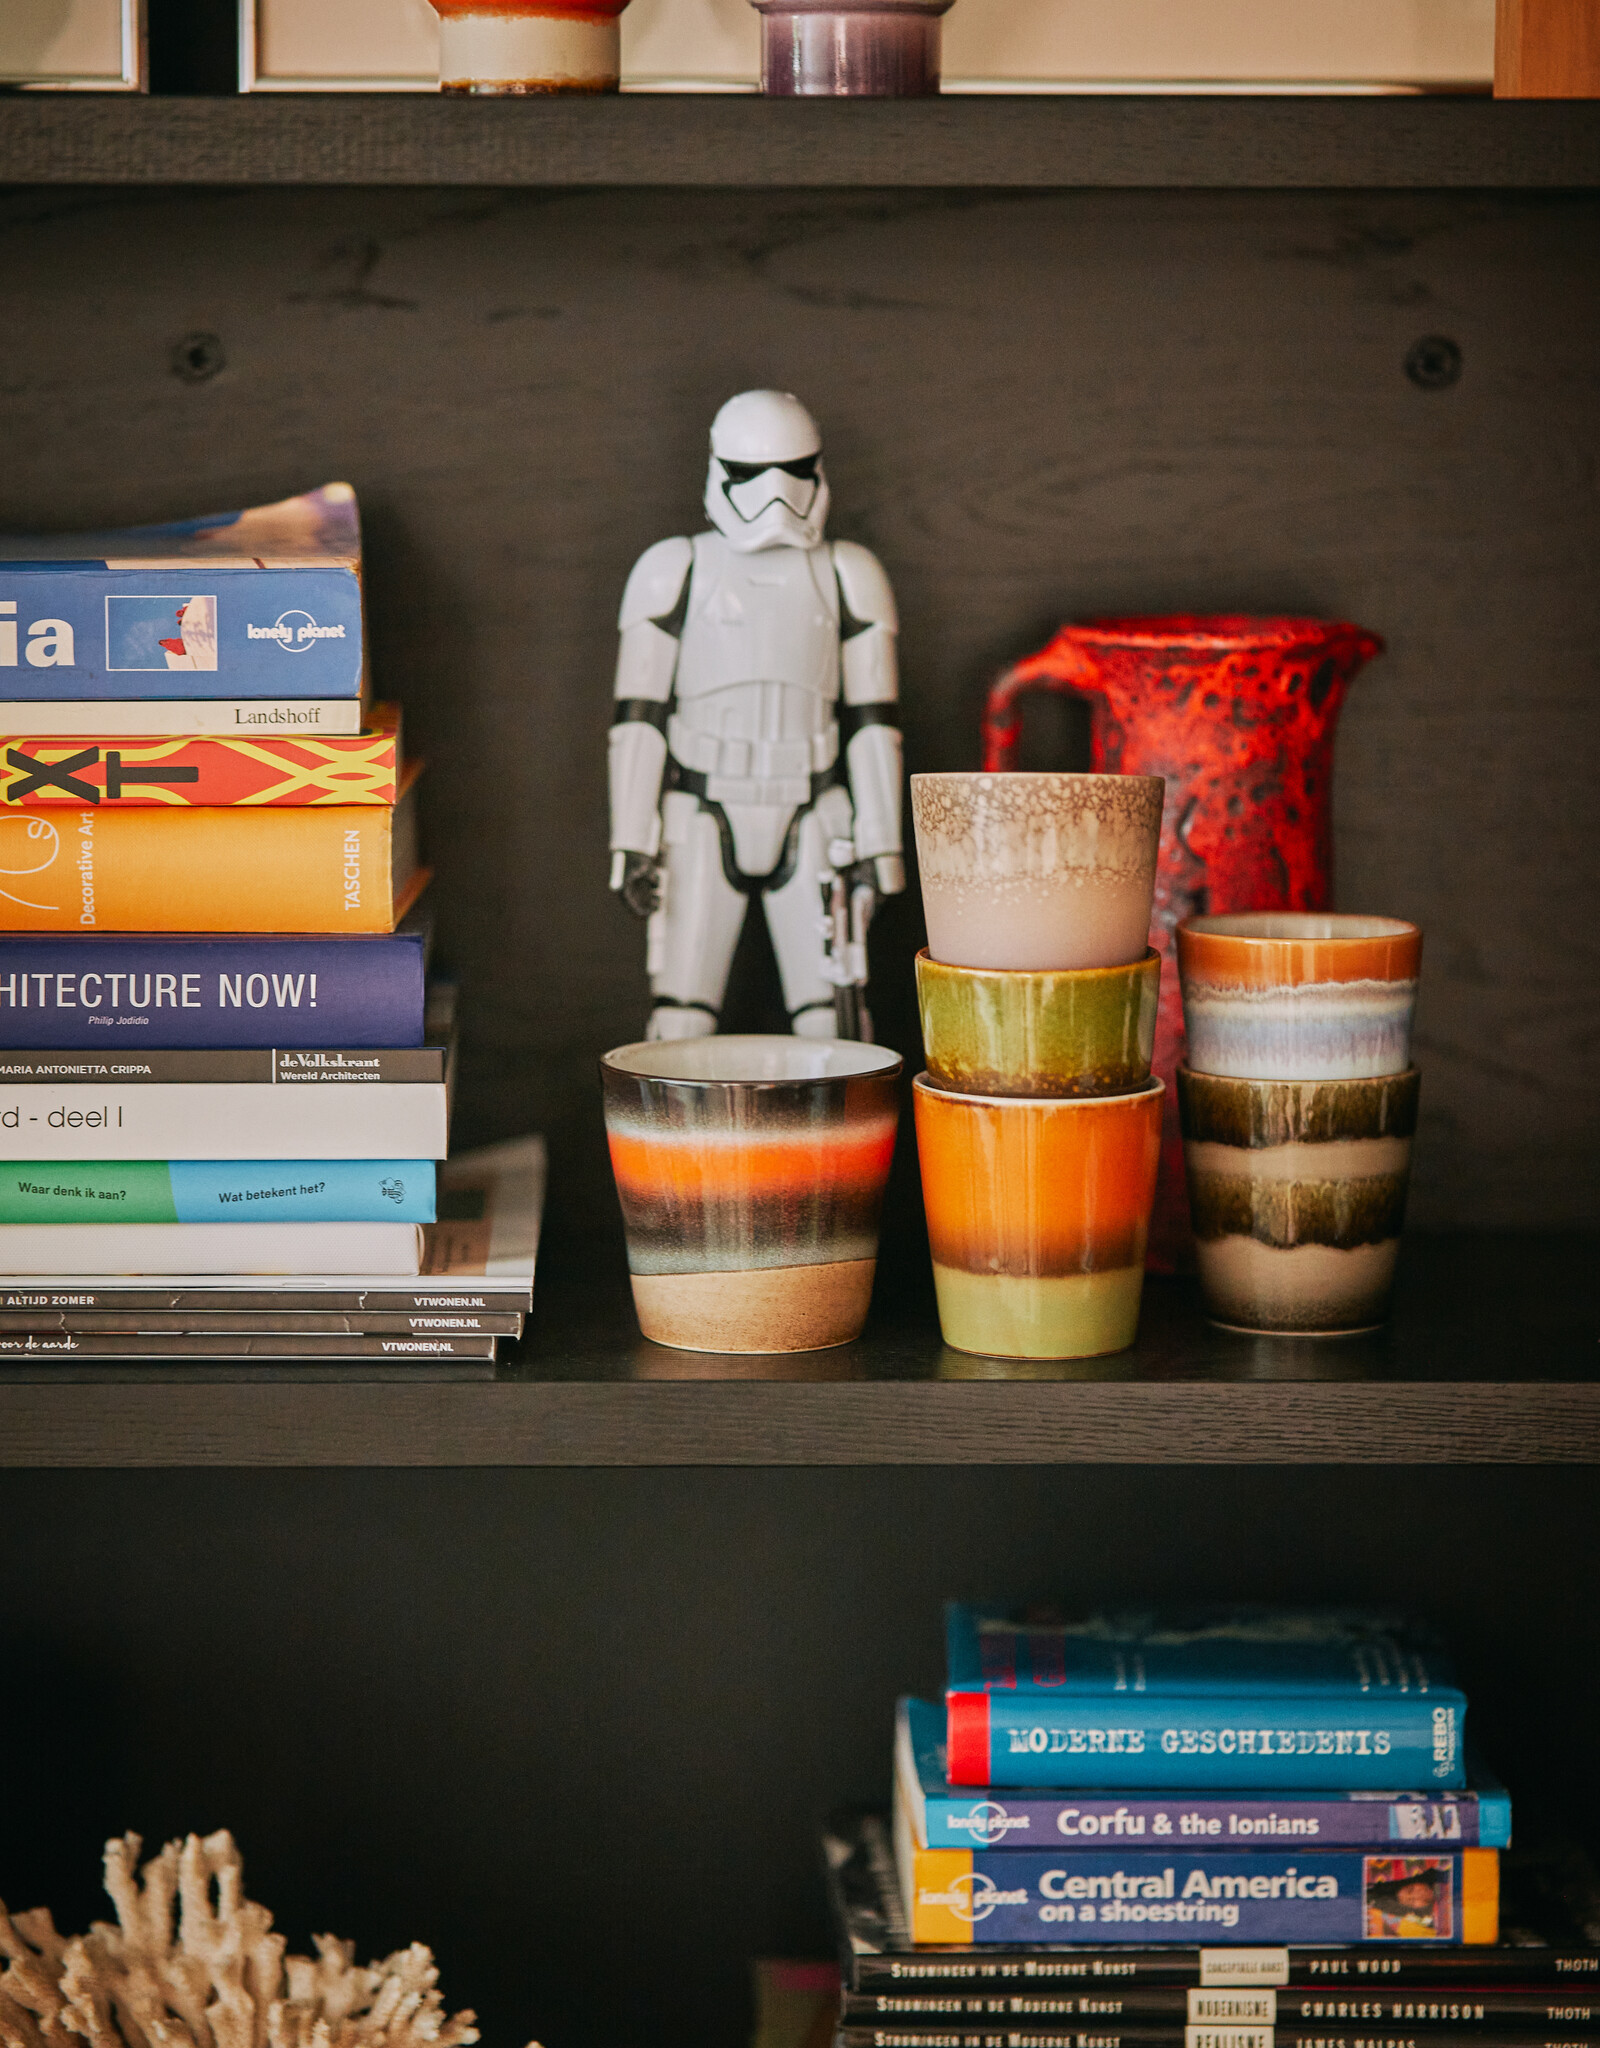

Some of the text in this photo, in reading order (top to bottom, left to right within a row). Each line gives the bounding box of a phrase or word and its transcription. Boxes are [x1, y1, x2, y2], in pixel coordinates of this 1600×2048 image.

[247, 623, 346, 643] lonely planet
[234, 708, 321, 724] Landshoff
[77, 811, 96, 925] Decorative Art
[343, 830, 361, 911] TASCHEN
[218, 973, 317, 1008] NOW!
[88, 1015, 149, 1026] Philip Jodidio
[35, 1065, 108, 1075] ANTONIETTA
[110, 1065, 152, 1075] CRIPPA
[280, 1071, 381, 1080] Wereld Architecten
[47, 1106, 107, 1128] deel
[18, 1181, 126, 1201] Waar denk ik aan?
[218, 1181, 325, 1203] Wat betekent het?
[6, 1296, 48, 1305] ALTIJD
[51, 1296, 95, 1305] ZOMER
[413, 1297, 486, 1307] VTWONEN.NL
[409, 1318, 481, 1328] VTWONEN.NL
[24, 1335, 40, 1350] de
[41, 1335, 80, 1350] aarde
[382, 1342, 454, 1352] VTWONEN.NL
[1008, 1728, 1392, 1755] MODERNE GESCHIEDENIS
[1432, 1706, 1447, 1761] REBO
[1056, 1807, 1320, 1836] Corfu & the Ionians
[1038, 1867, 1339, 1900] Central America
[1038, 1899, 1240, 1928] on a shoestring
[1309, 1959, 1349, 1975] PAUL
[1555, 1958, 1599, 1972] THOTH
[1300, 2002, 1485, 2019] CHARLES HARRISON
[1546, 2006, 1591, 2020] THOTH
